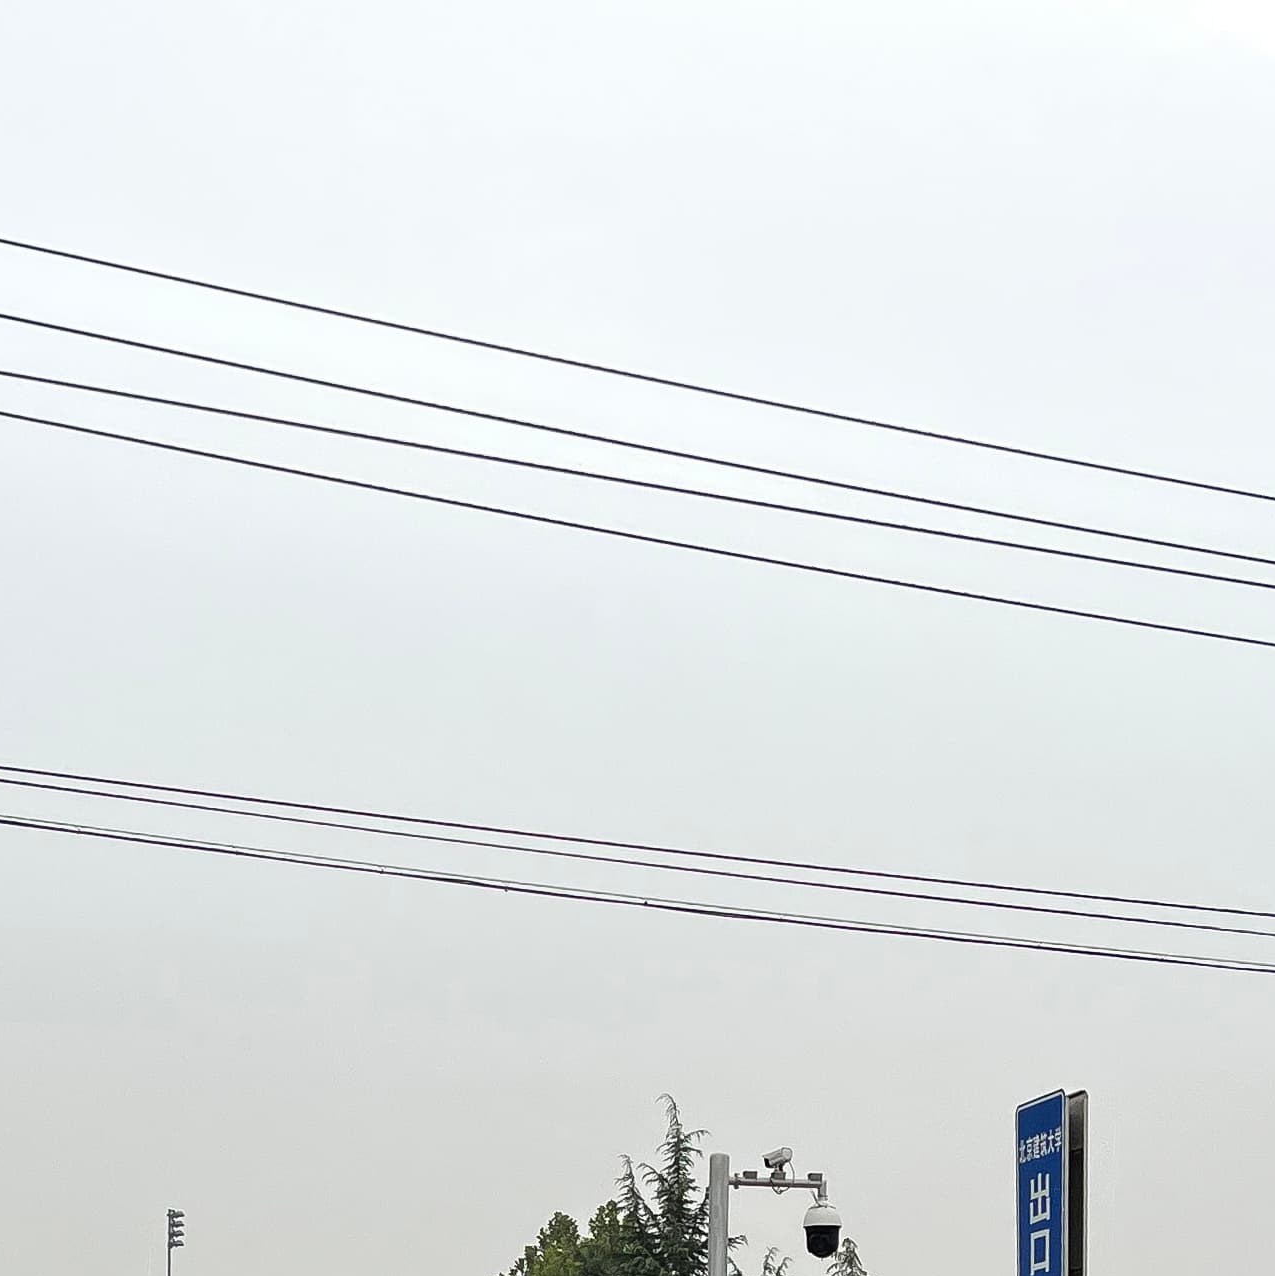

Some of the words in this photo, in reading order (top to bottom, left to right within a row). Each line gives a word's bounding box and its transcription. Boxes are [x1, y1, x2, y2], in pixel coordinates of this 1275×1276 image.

[1018, 1126, 1062, 1164] 北京建筑大学
[1029, 1172, 1051, 1276] 出口
